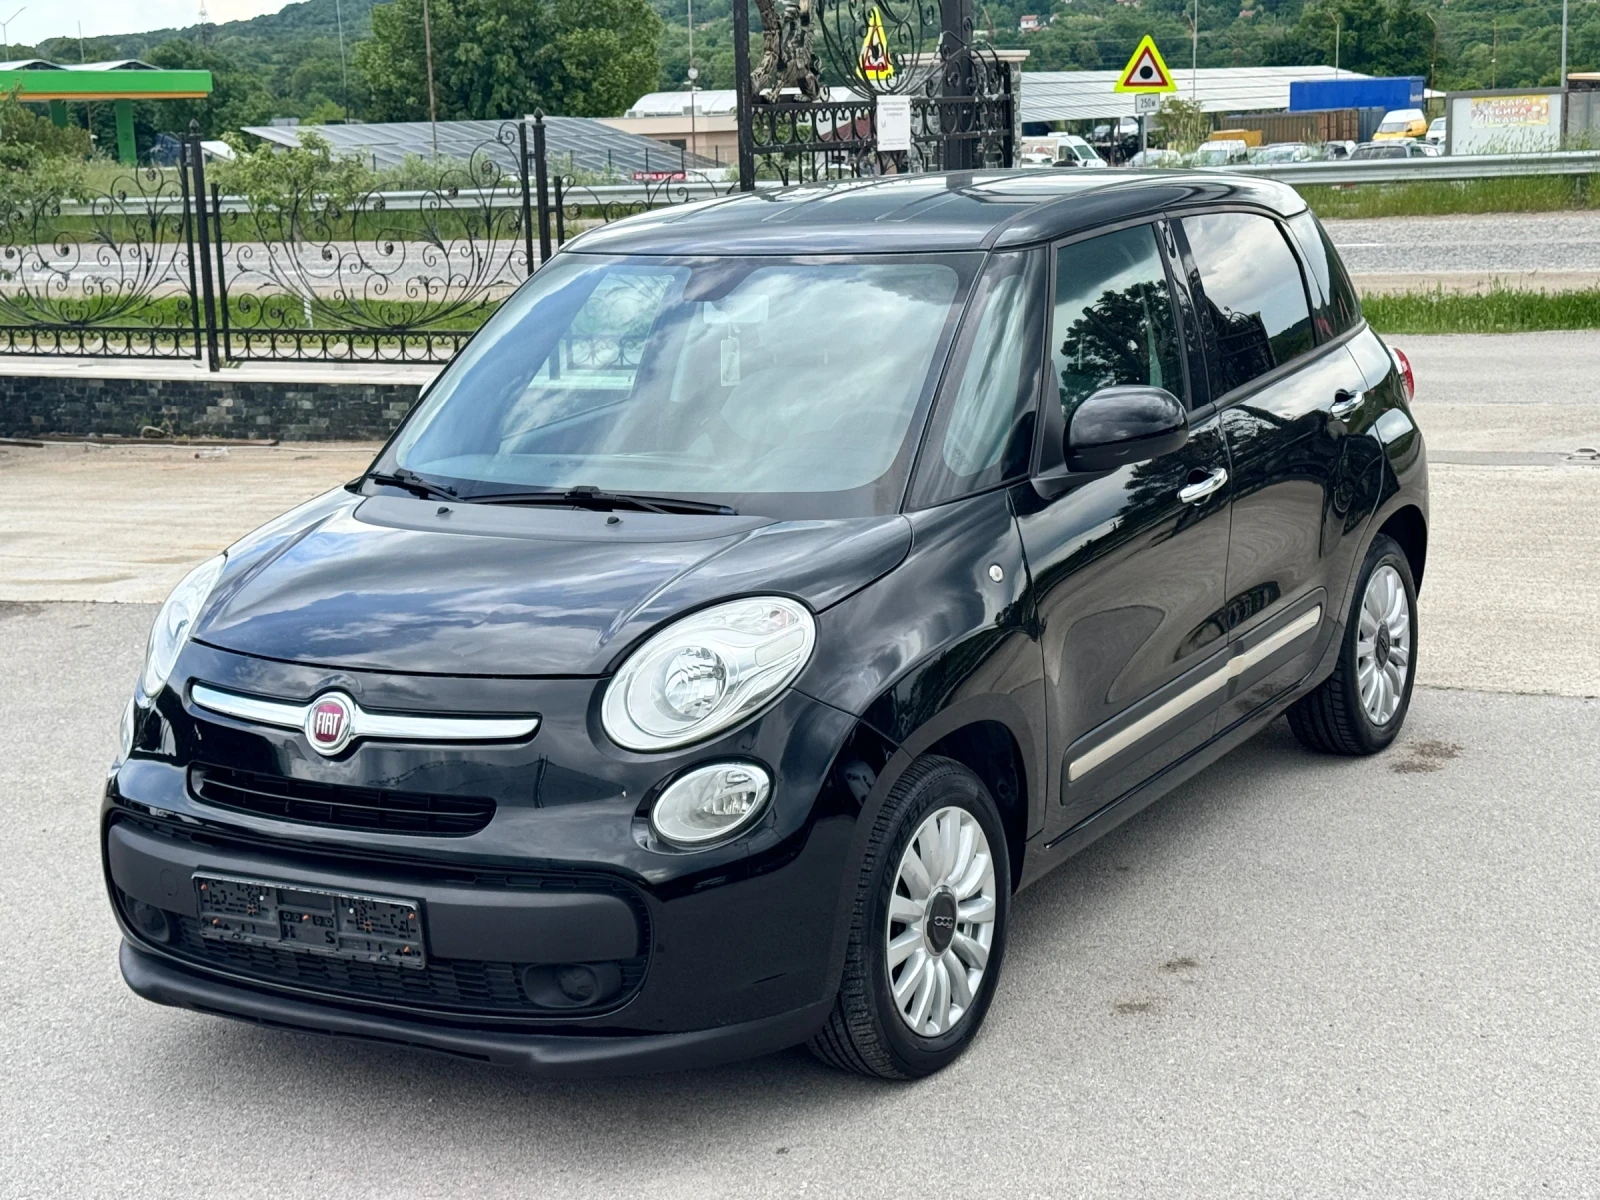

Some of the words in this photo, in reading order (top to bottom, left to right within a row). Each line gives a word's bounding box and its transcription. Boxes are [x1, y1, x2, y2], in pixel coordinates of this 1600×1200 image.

[1491, 98, 1530, 106] СКАРА
[1495, 107, 1527, 115] БИРА
[1494, 116, 1526, 124] КАФЕ
[315, 711, 341, 736] FIAT
